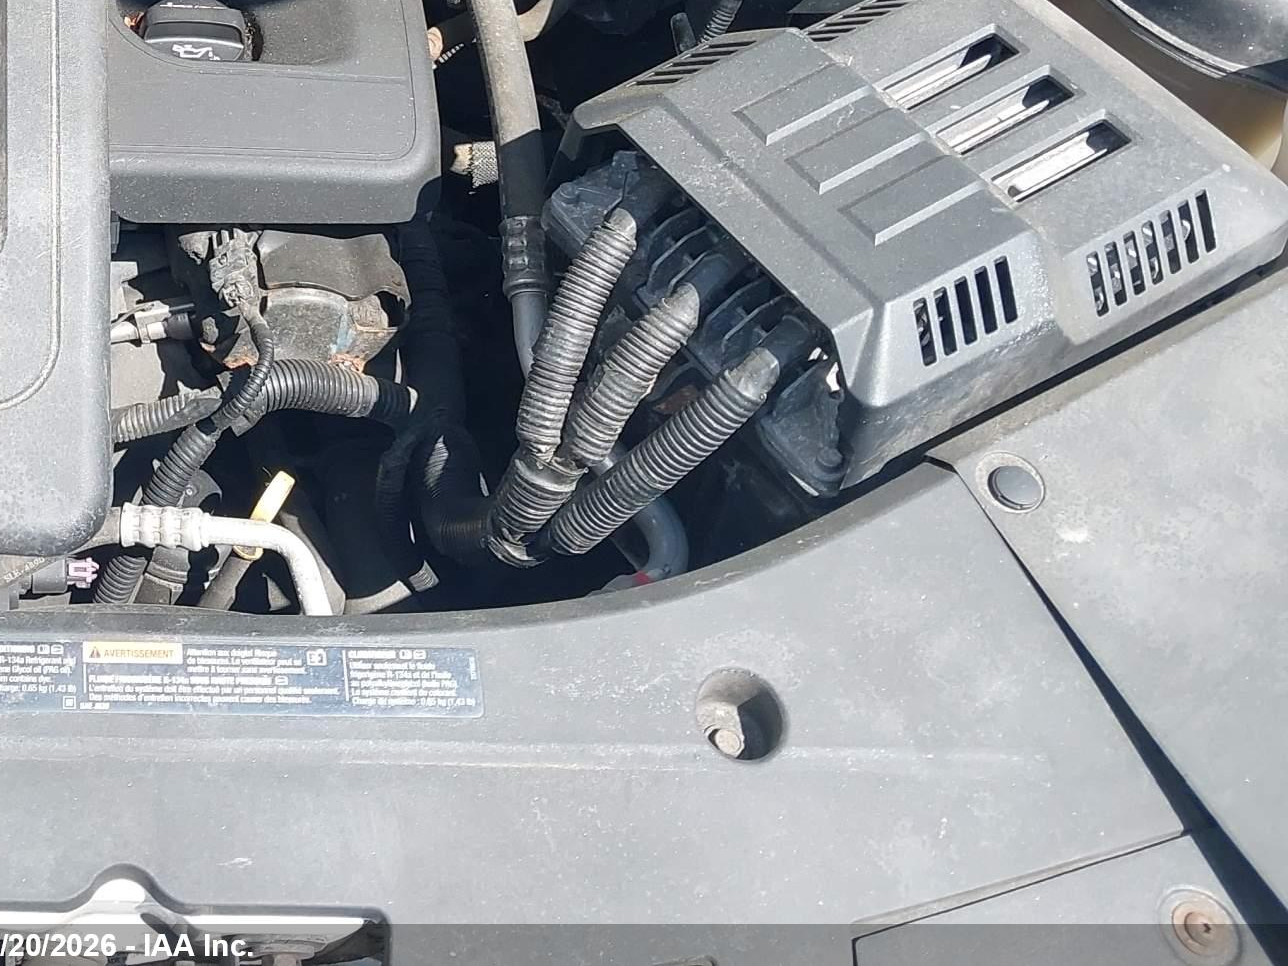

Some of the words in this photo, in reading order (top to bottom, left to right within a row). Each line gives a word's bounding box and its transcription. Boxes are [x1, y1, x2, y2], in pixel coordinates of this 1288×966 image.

[104, 650, 173, 658] AVERTISSEMENT
[0, 656, 24, 665] R-134a
[9, 675, 36, 684] contains
